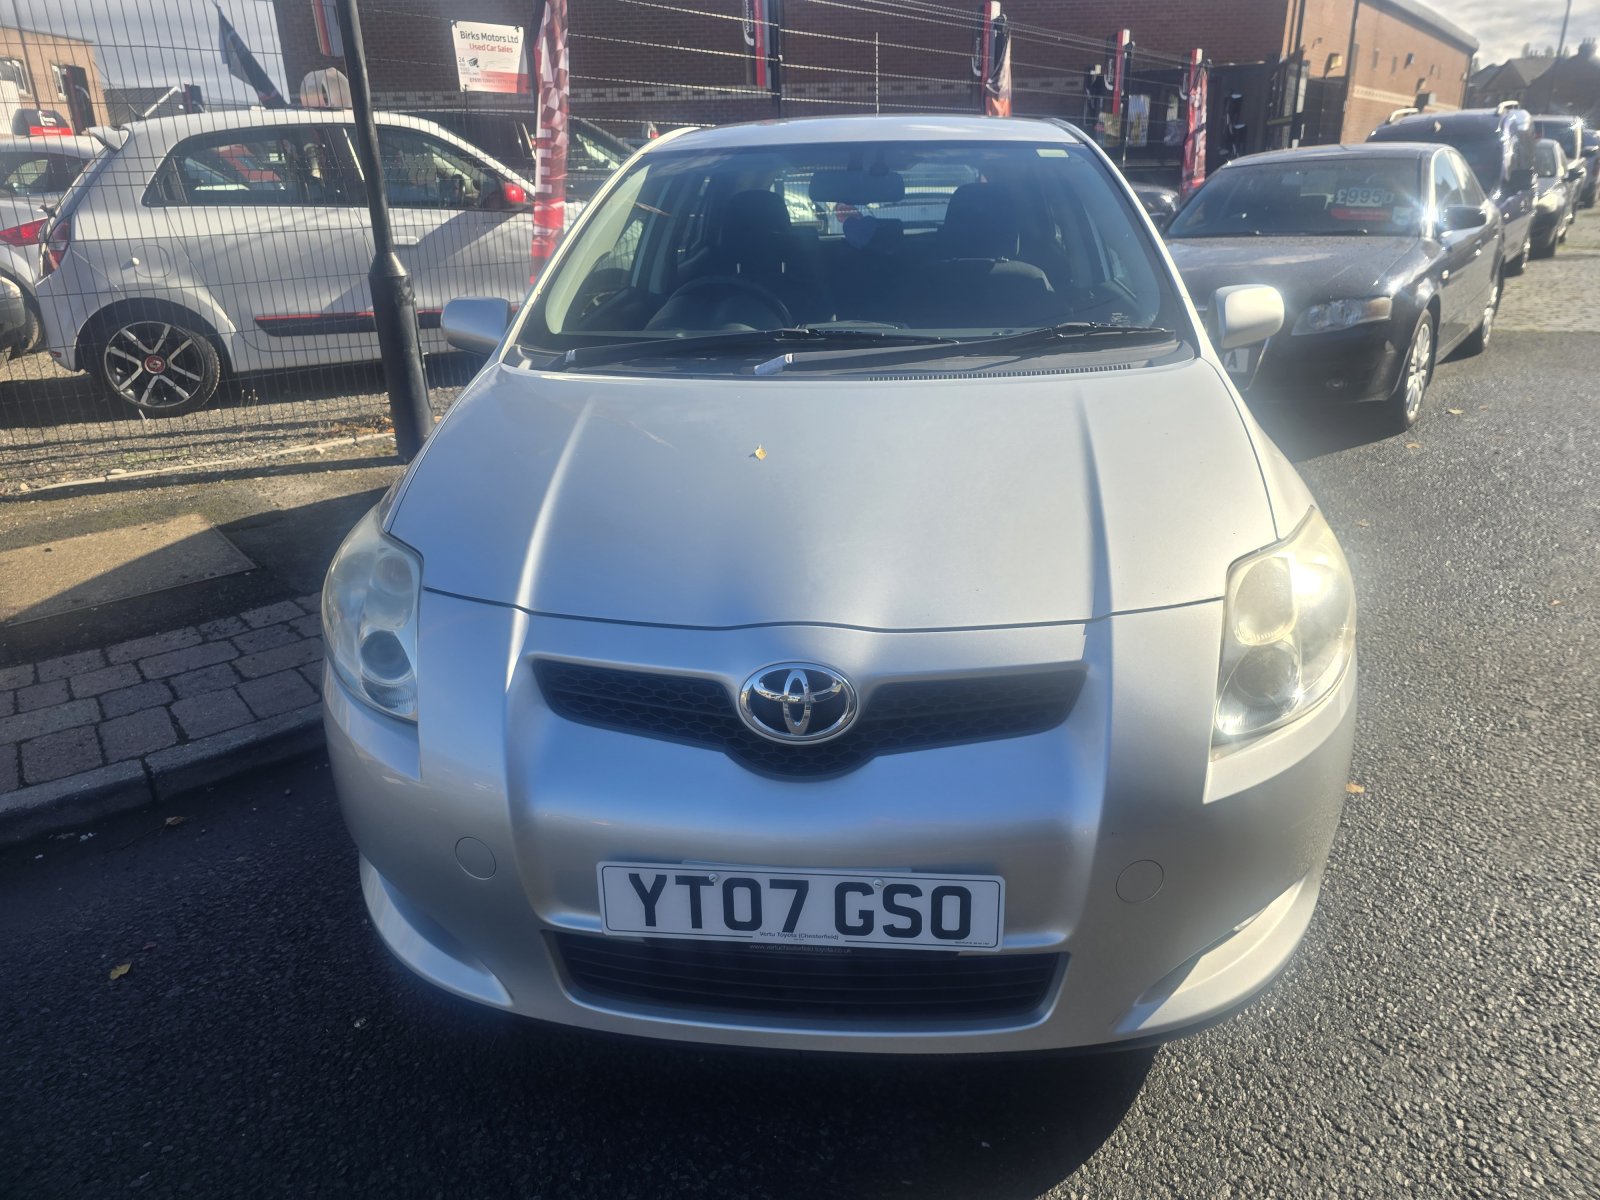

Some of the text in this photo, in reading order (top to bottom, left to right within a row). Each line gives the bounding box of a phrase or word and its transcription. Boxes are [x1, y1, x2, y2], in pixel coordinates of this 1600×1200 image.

[460, 31, 519, 43] Birks Motors Ltd
[469, 43, 513, 53] Used Car Sales
[628, 873, 973, 940] YT07 GSO
